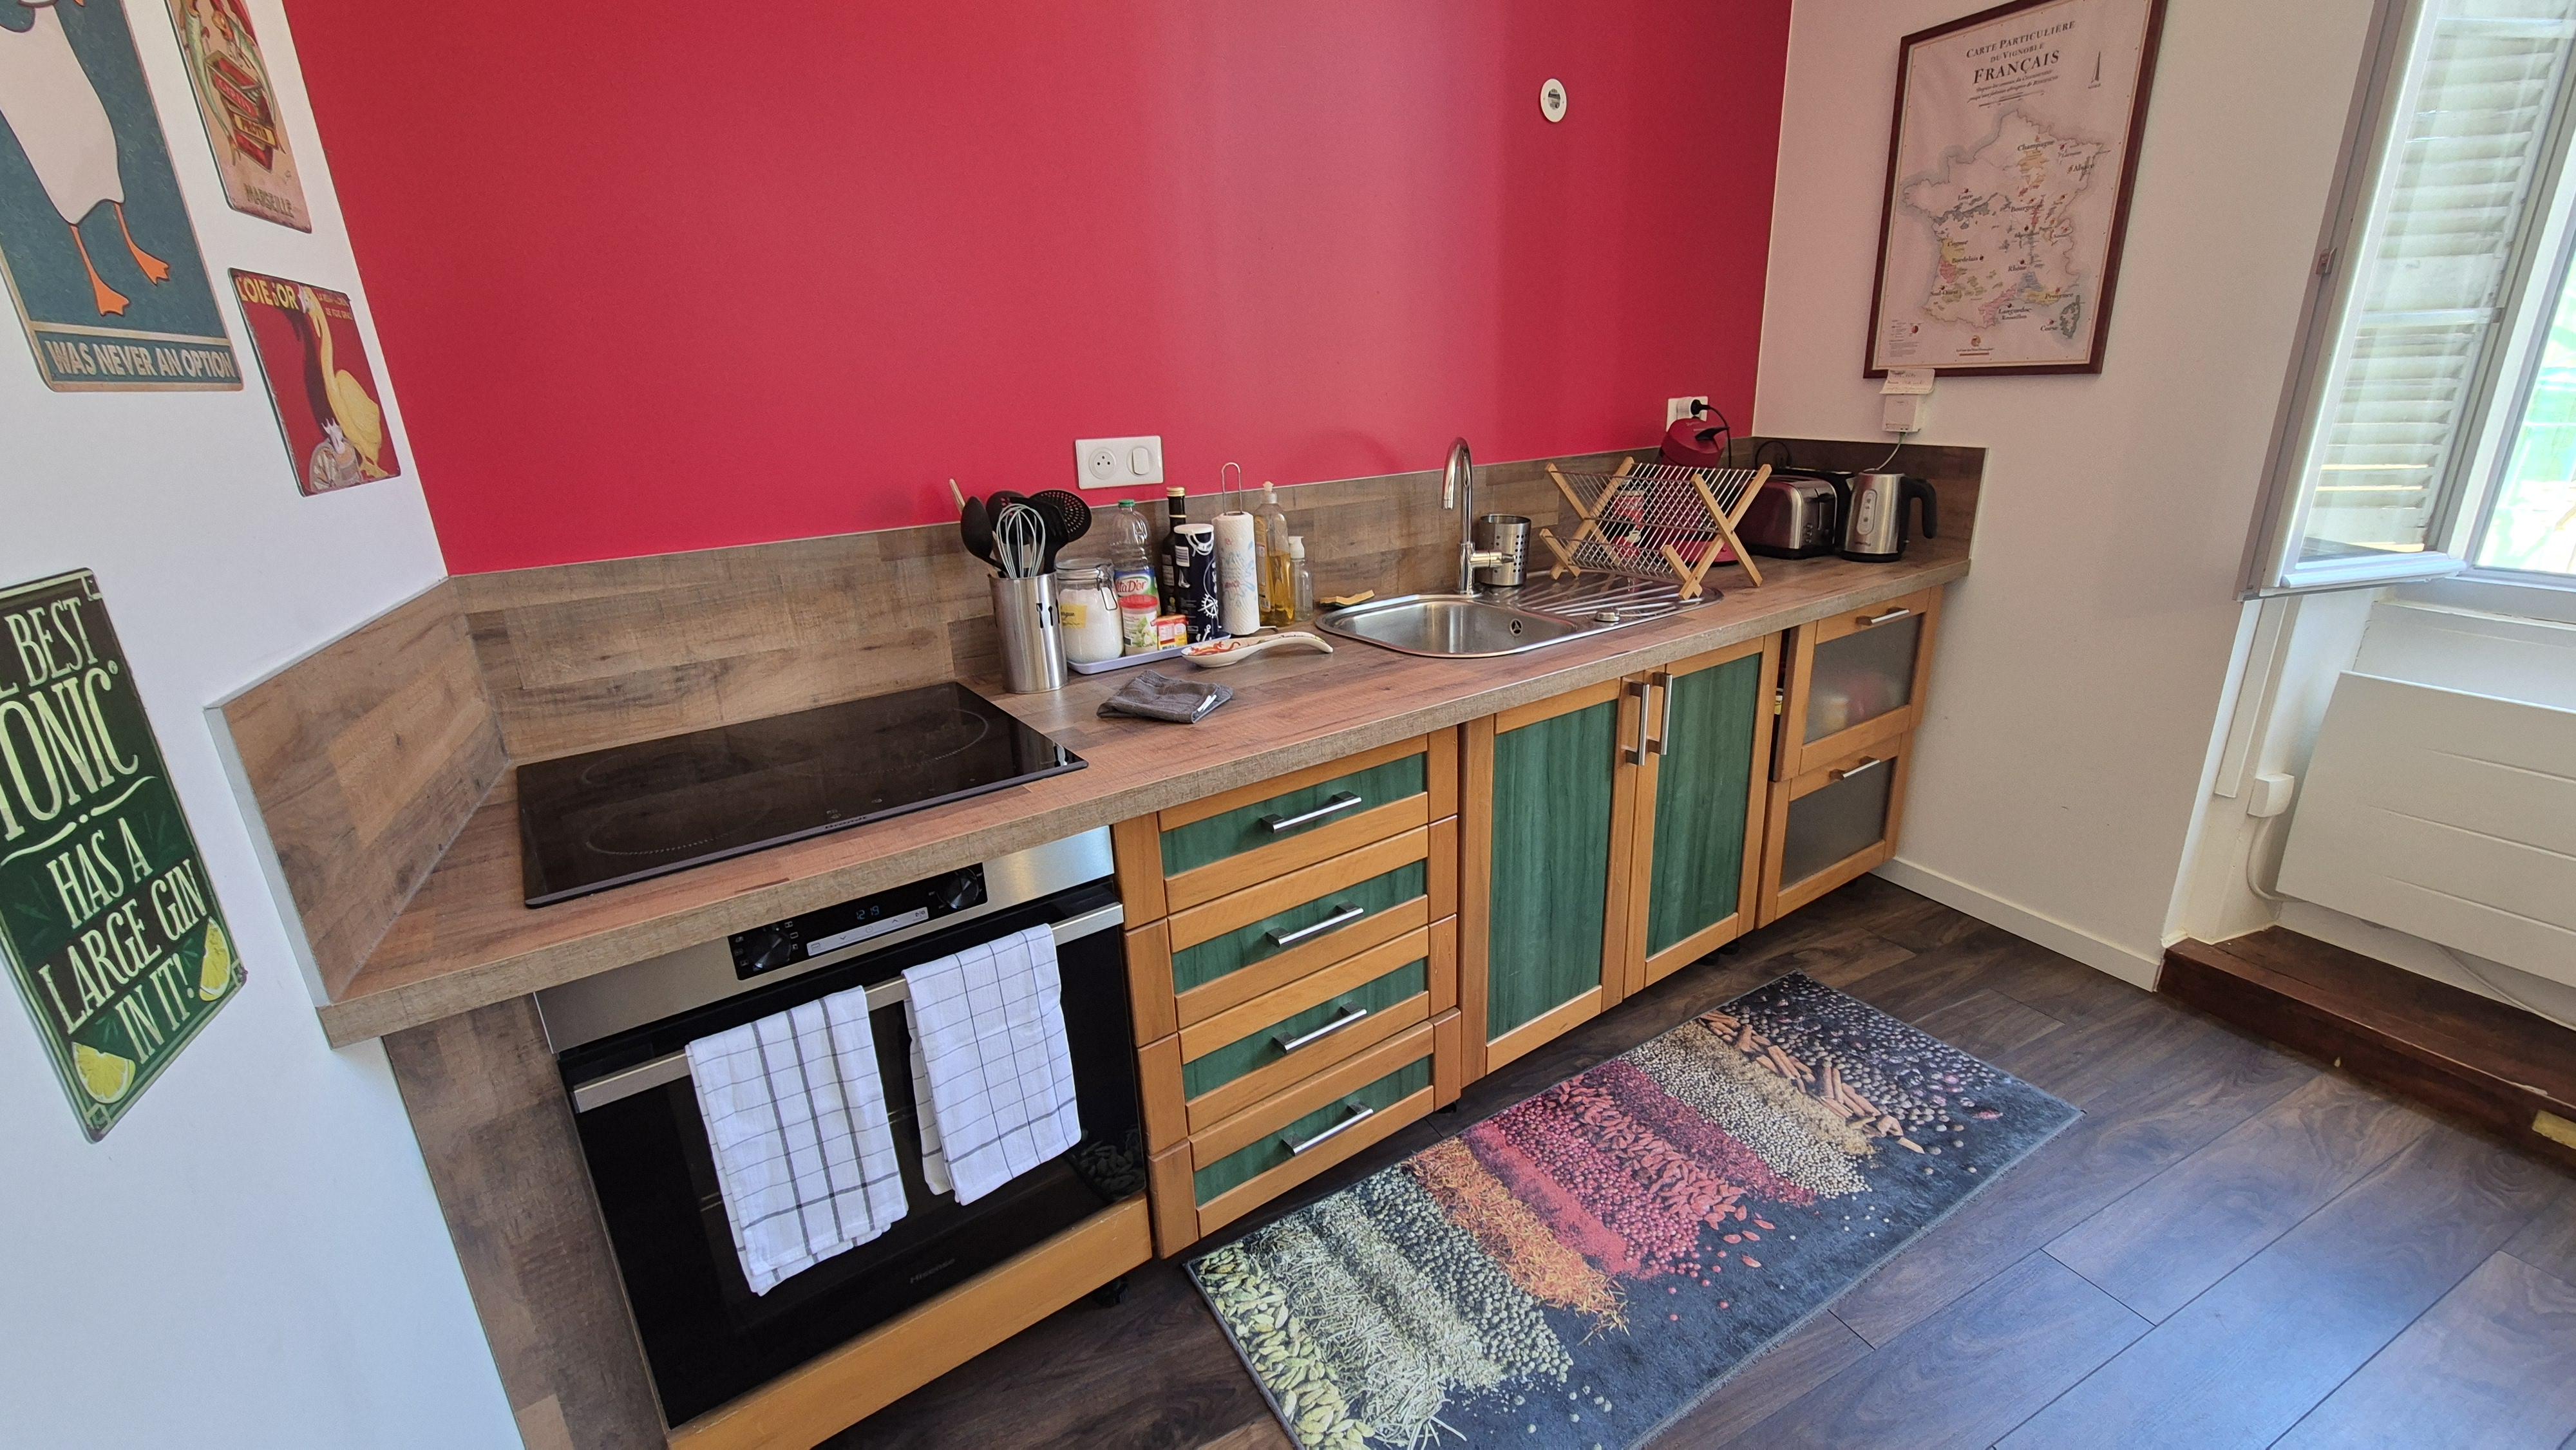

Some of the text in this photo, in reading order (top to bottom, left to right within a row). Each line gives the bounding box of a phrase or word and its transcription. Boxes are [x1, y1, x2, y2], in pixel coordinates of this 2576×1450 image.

[1966, 21, 2076, 58] CARTE PARTICULIÈRE
[2003, 42, 2045, 59] VIGNOBLE
[1973, 50, 2061, 85] FRANÇAIS
[2017, 140, 2055, 151] Champagne
[243, 183, 294, 218] MARSEILLE
[2045, 292, 2074, 300] Provence
[45, 340, 236, 378] WAS NEVER AN OPTION
[5, 597, 98, 687] BEST
[46, 817, 153, 929] HAS A
[38, 858, 207, 1035] LARGE GIN
[115, 953, 194, 1064] IN IT!
